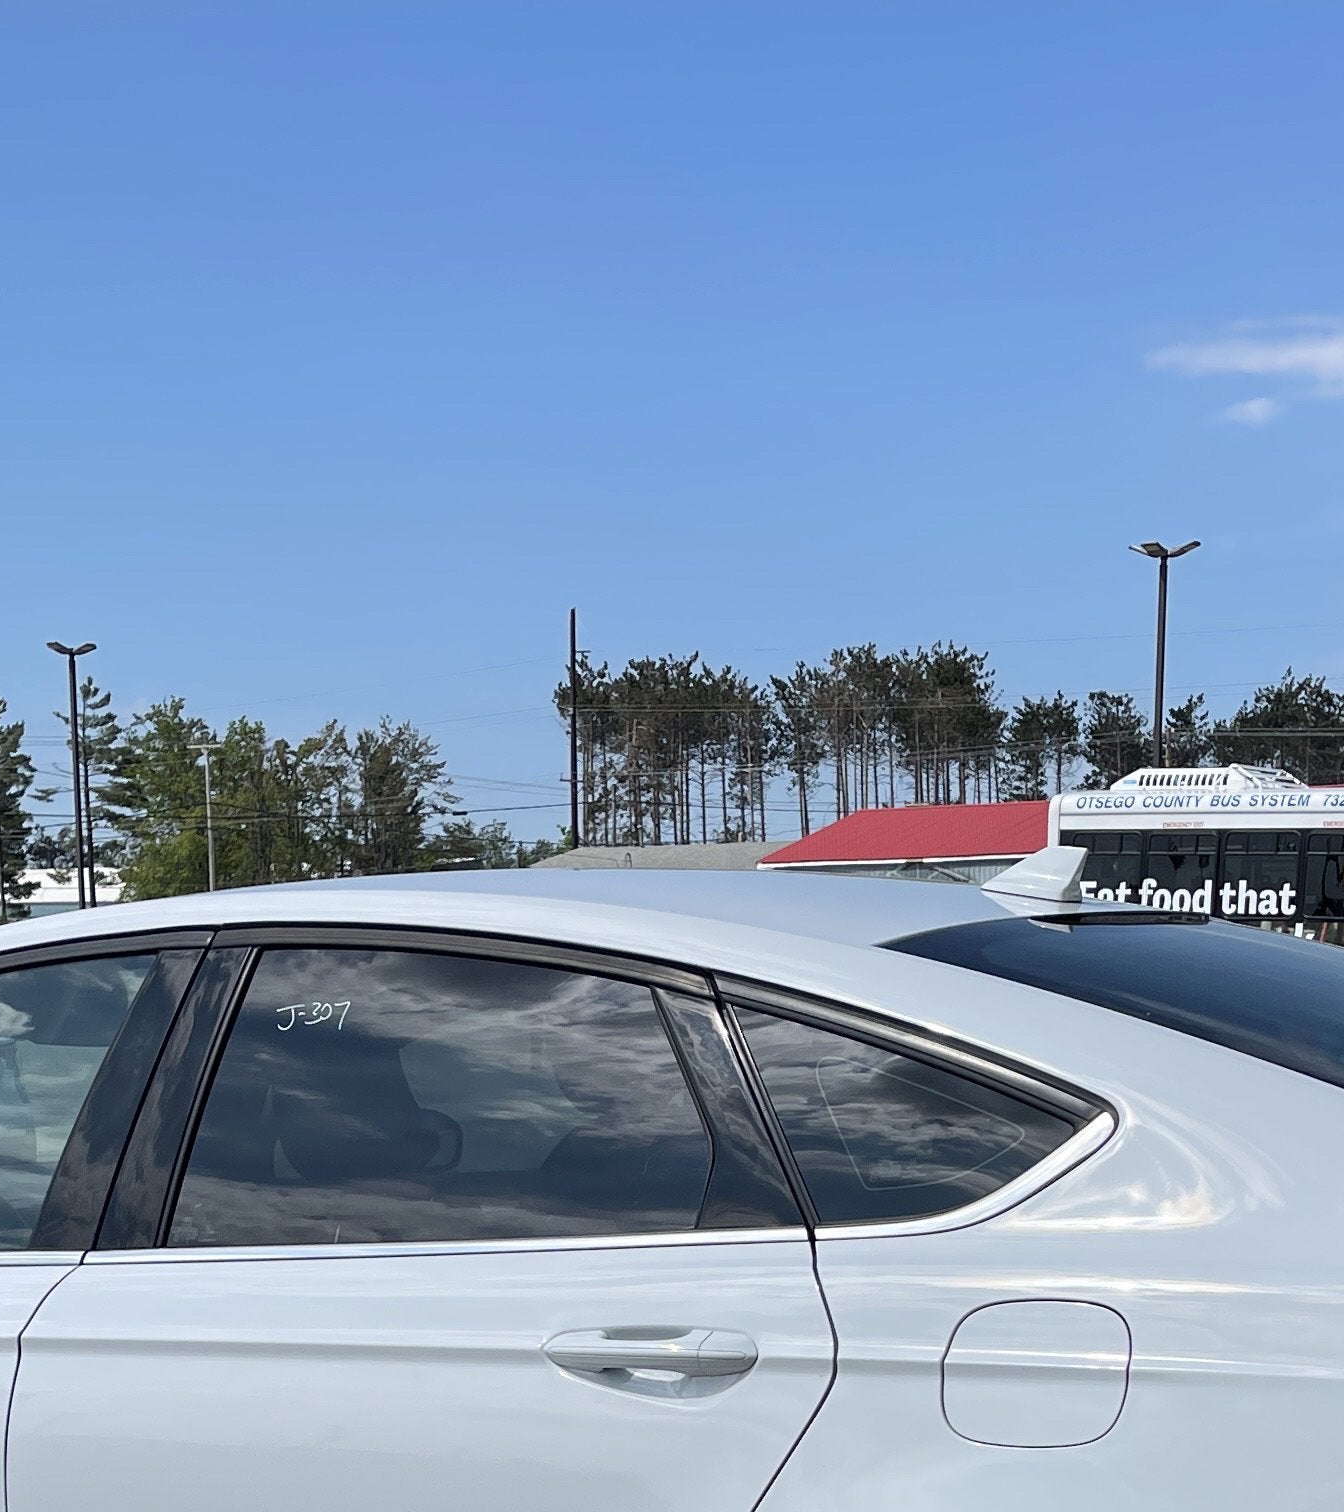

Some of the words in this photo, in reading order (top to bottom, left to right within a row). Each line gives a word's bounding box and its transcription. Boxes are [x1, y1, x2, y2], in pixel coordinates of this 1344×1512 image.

[1076, 796, 1135, 809] OTSEGO
[1142, 795, 1204, 808] COUNTY
[1210, 794, 1242, 807] BUS
[1248, 794, 1312, 807] SYSTEM
[1138, 878, 1212, 915] food
[1219, 880, 1296, 916] that
[275, 1000, 351, 1032] J-307
